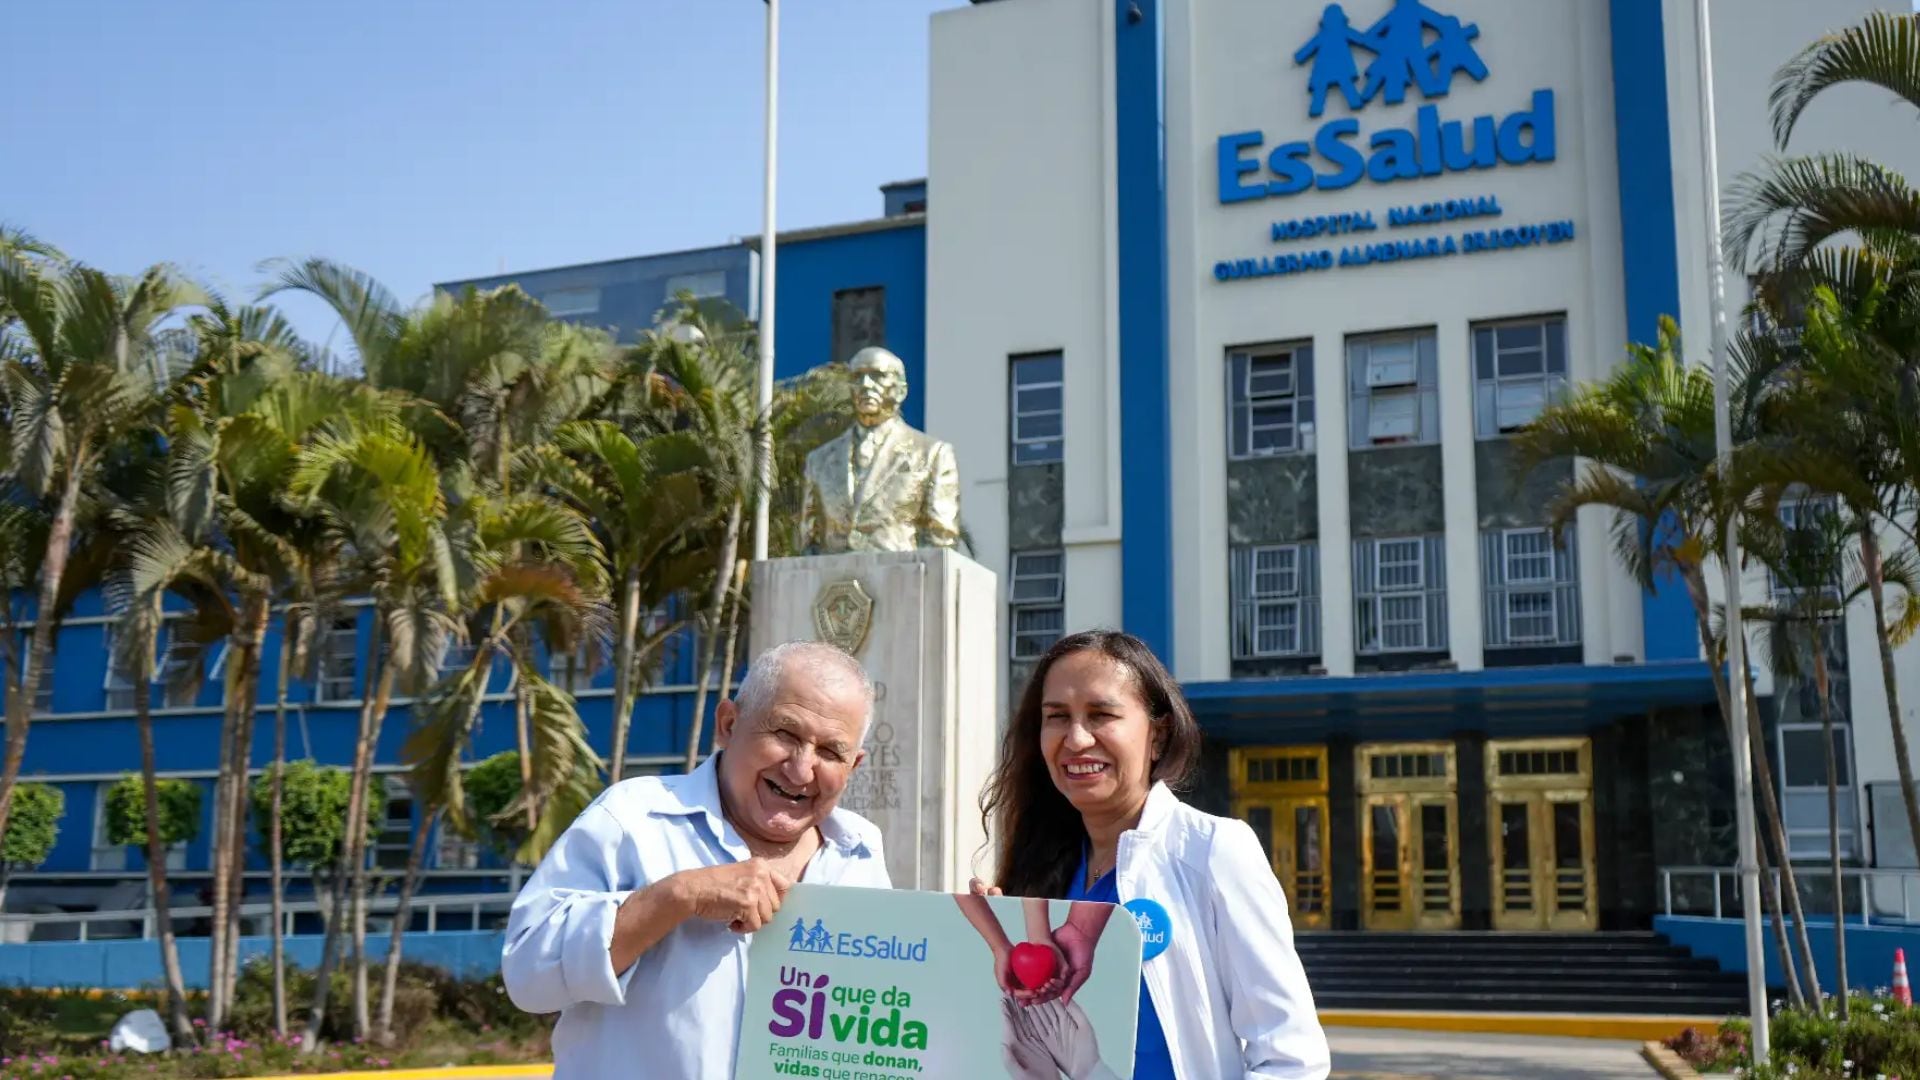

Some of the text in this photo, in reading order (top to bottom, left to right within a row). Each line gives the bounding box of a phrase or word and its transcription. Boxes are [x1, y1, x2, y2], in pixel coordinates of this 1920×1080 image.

[1217, 89, 1556, 205] EsSalud
[1272, 195, 1502, 242] HOSPITAL NACIONAL
[1214, 219, 1575, 281] GUILLERMO ALMENARA IRIGOYEN
[836, 933, 927, 962] EsSalud
[780, 966, 811, 987] Un
[831, 985, 911, 1008] que da
[830, 1005, 928, 1050] vida
[769, 1042, 923, 1072] Familias que donan,
[774, 1059, 819, 1077] vidas
[822, 1068, 850, 1080] que
